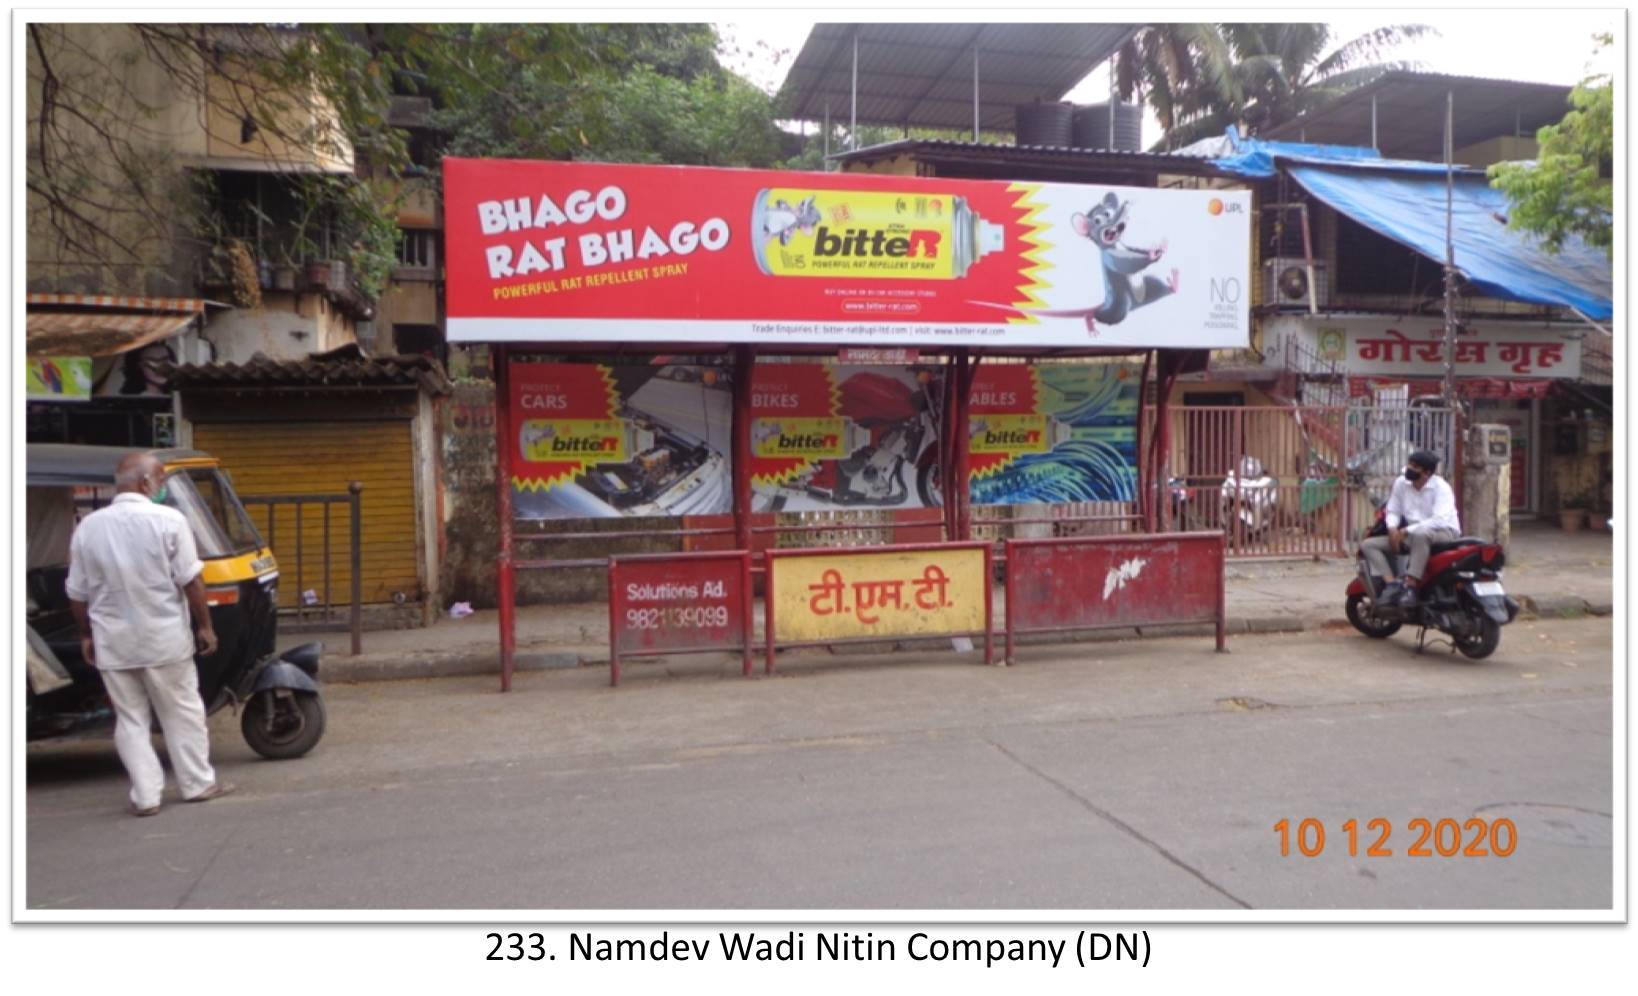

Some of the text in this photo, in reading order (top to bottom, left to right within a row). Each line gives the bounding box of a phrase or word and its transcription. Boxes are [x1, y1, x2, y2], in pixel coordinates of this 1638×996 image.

[477, 185, 627, 235] BHAGO
[1224, 203, 1243, 213] UPL
[485, 217, 731, 279] RAT BHAGO
[493, 263, 688, 300] POWERFUL RAT REPELLENT SPRAY
[1210, 277, 1240, 303] NO
[752, 323, 774, 333] Trade
[776, 323, 812, 336] Enquiries
[1496, 342, 1565, 374] गृह
[520, 394, 568, 409] CARS
[752, 394, 799, 408] BIKES
[969, 392, 1017, 406] ABLES
[626, 581, 727, 601] Solutions Ad.
